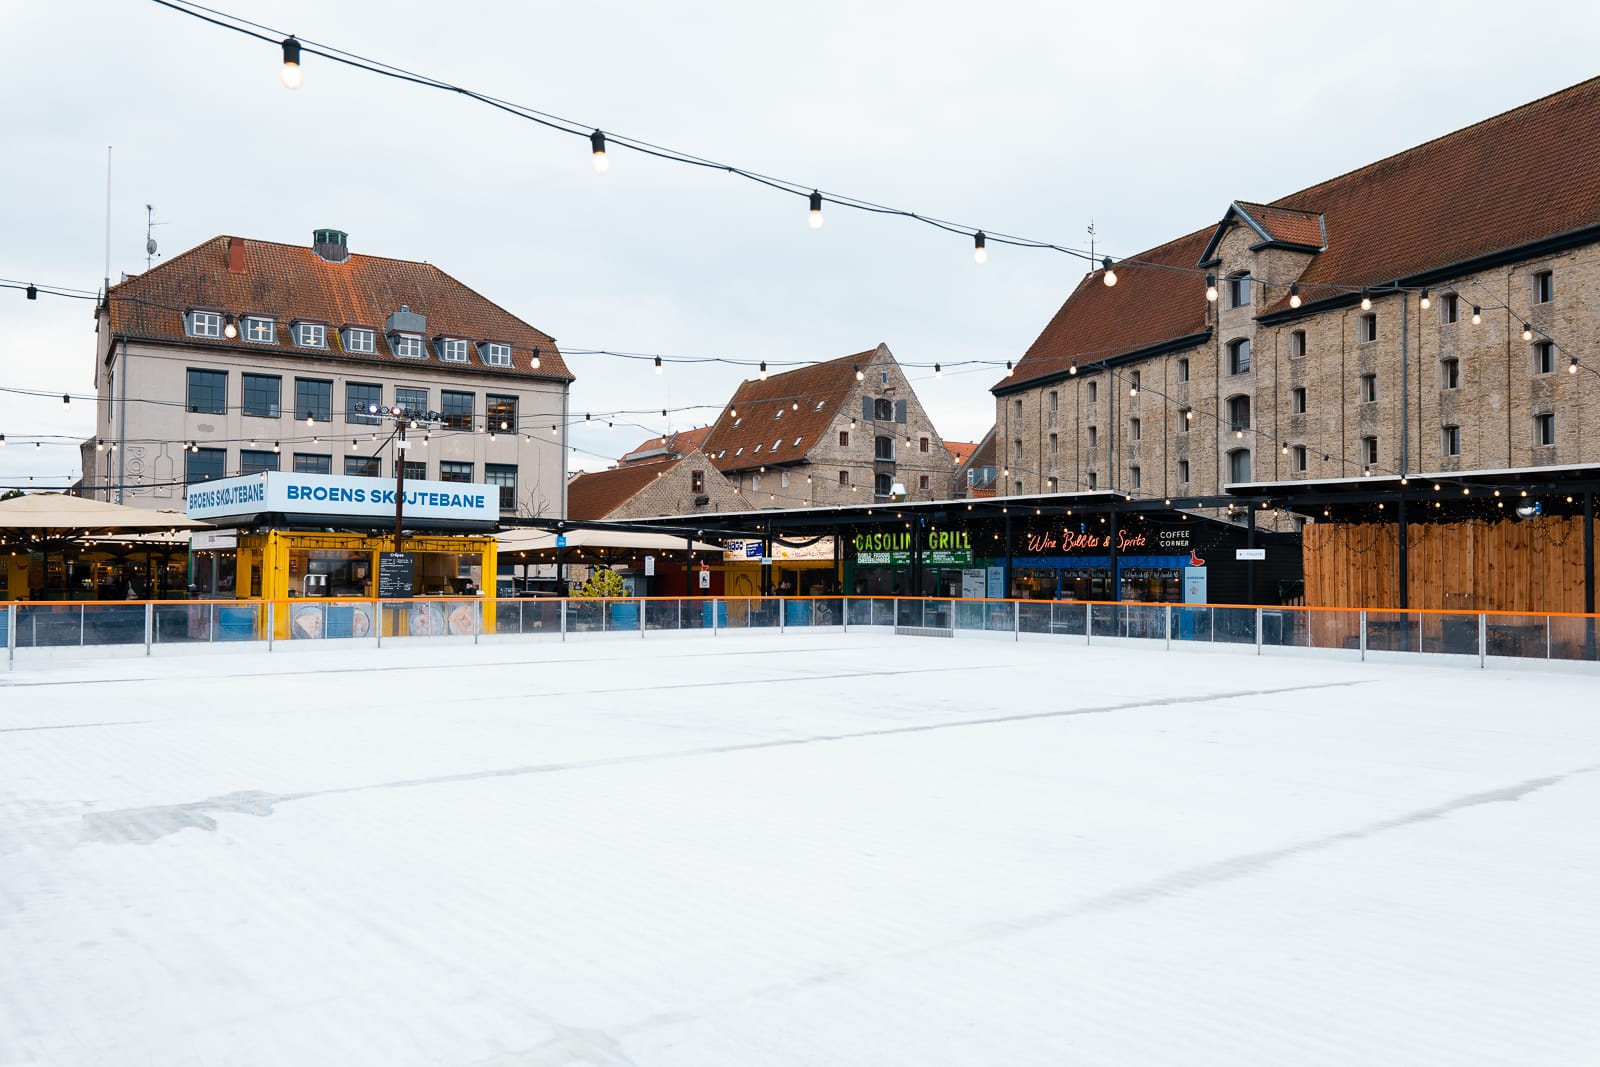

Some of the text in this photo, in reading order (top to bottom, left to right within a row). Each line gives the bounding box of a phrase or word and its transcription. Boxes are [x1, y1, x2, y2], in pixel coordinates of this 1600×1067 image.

[189, 483, 264, 510] BROENS SKØJTEBANE
[287, 485, 485, 508] BROENS SKØJTEBANE
[855, 531, 971, 551] GASOLIN GRILL
[1063, 531, 1099, 551] Bubbles
[1102, 536, 1110, 547] &
[1116, 529, 1146, 552] Spritz
